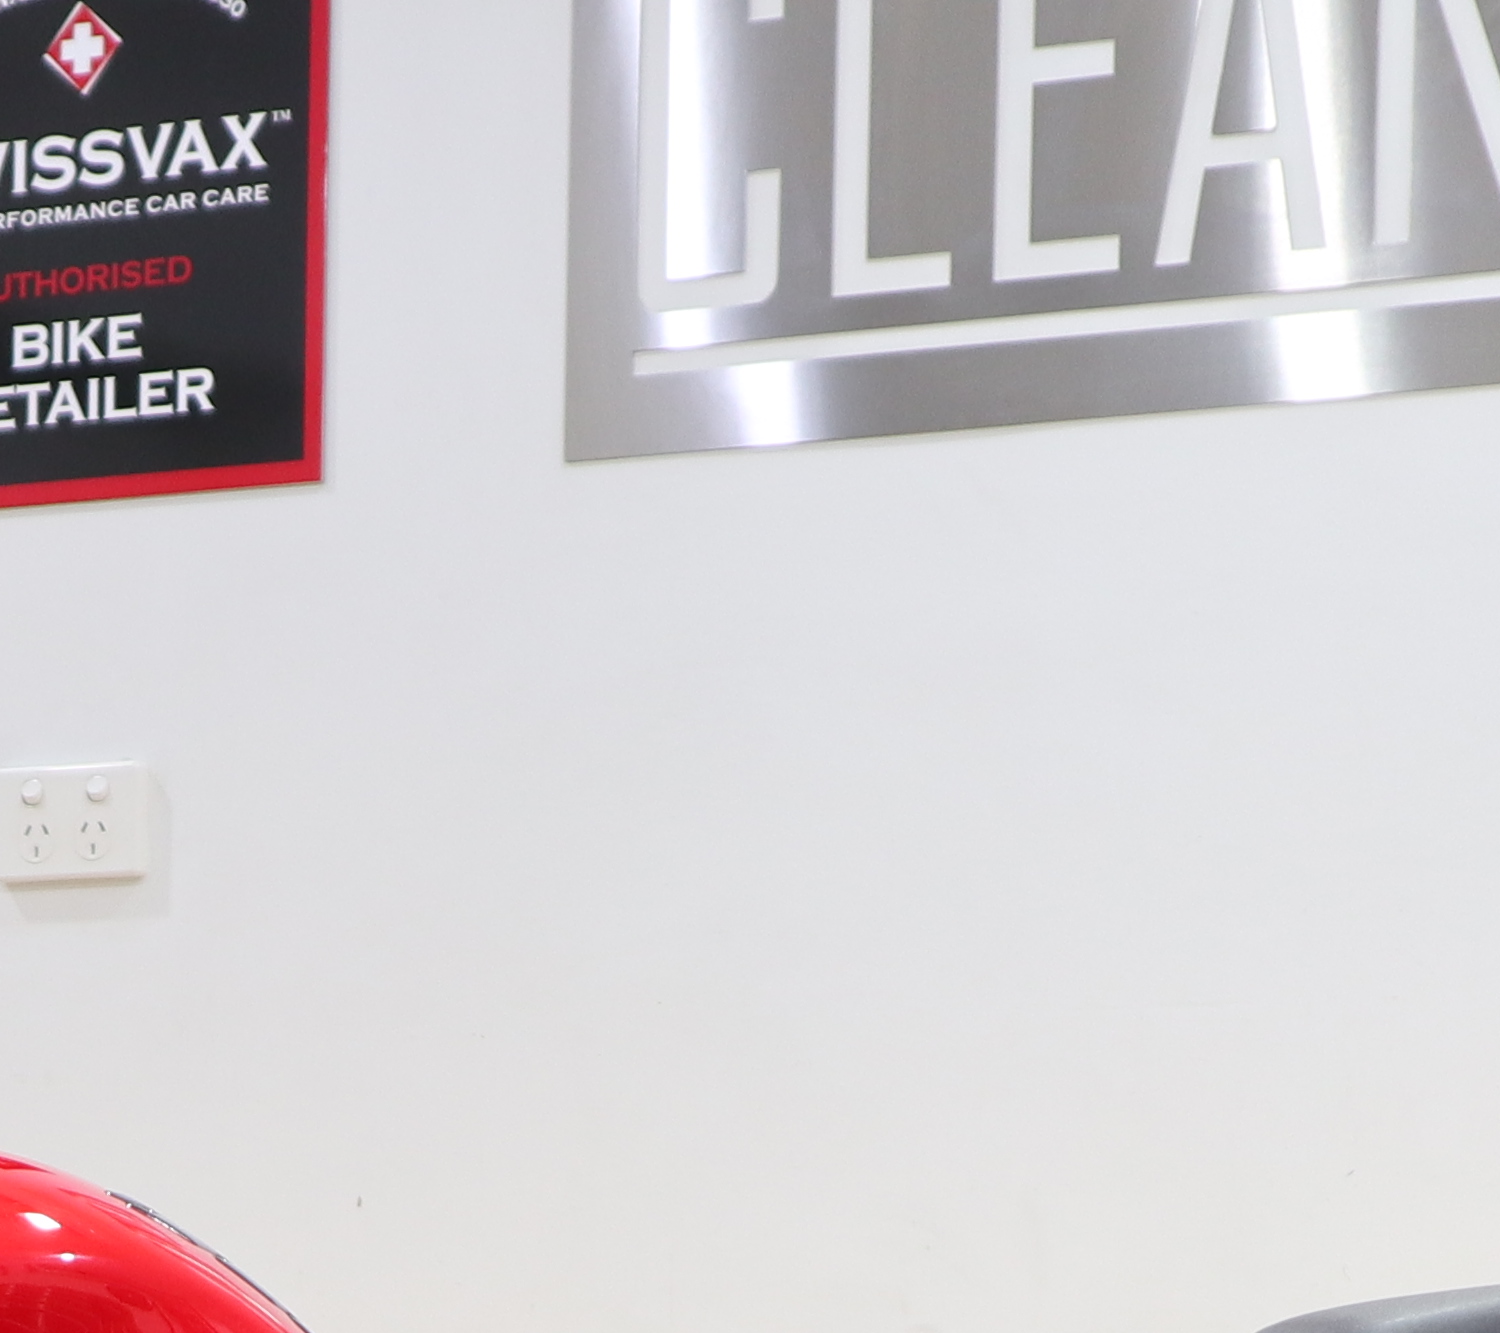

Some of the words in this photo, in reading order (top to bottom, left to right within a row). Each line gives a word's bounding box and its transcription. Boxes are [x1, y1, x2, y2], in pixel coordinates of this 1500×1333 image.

[146, 191, 197, 213] CAR
[202, 183, 270, 207] CARE
[11, 313, 143, 370] BIKE
